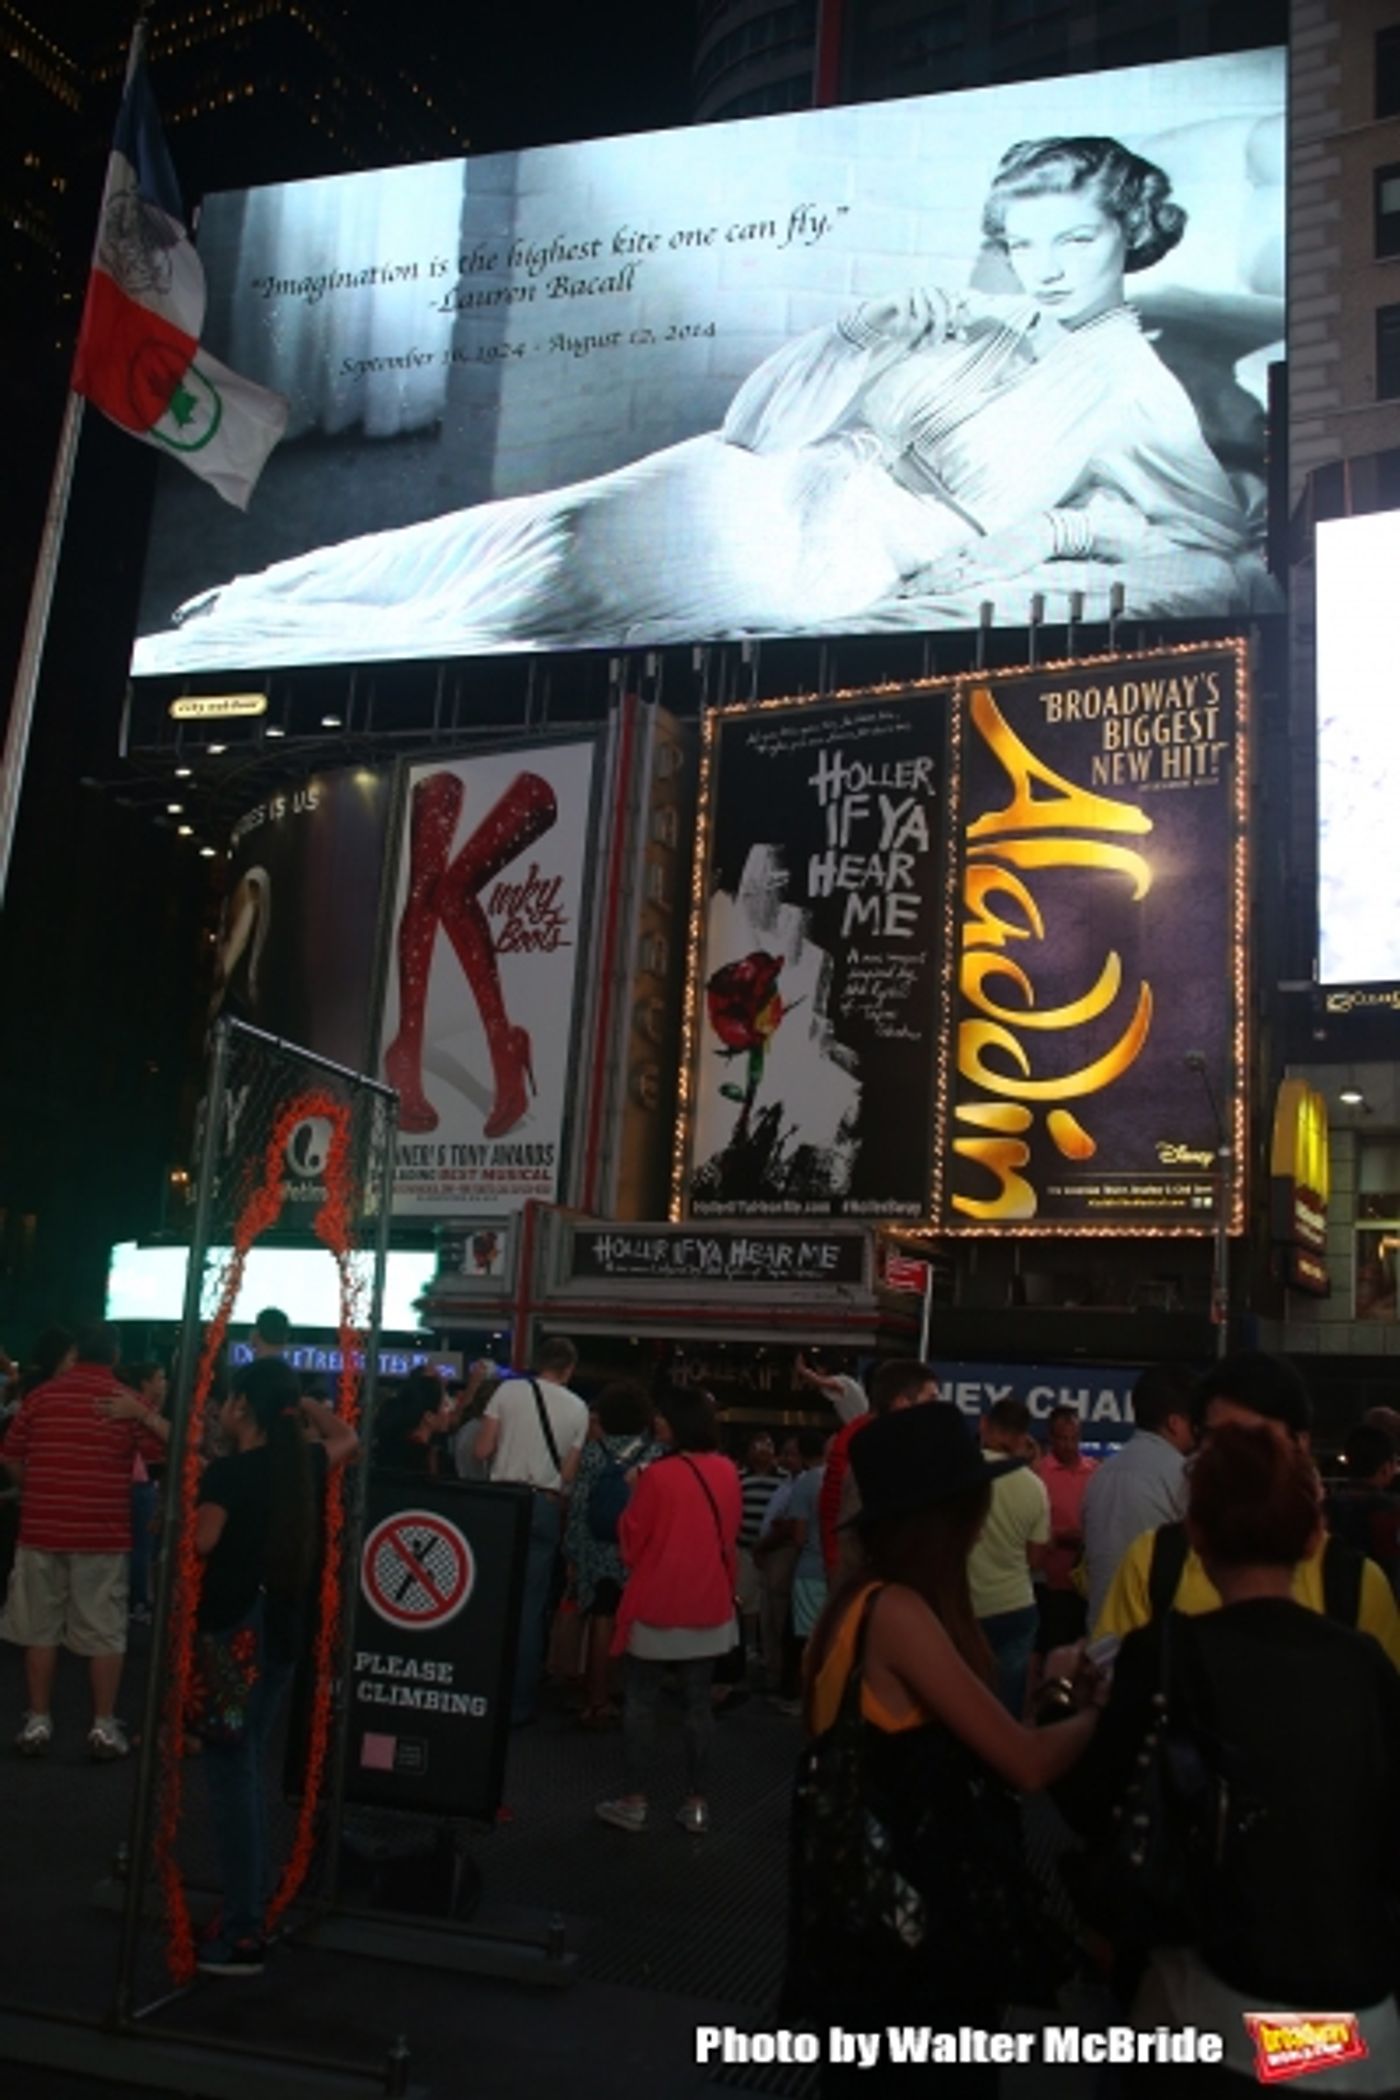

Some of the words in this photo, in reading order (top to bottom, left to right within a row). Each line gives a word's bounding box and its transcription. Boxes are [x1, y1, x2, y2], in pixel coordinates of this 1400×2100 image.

[429, 255, 449, 277] is
[459, 241, 498, 275] the
[507, 232, 602, 276] highest
[611, 224, 662, 255] kite
[668, 225, 719, 250] one
[725, 219, 776, 242] can
[546, 259, 644, 299] Bacall
[339, 347, 434, 382] September
[475, 342, 526, 365] 1924
[549, 328, 622, 358] August
[629, 327, 656, 346] 12,
[664, 321, 717, 341] 2014
[1102, 707, 1220, 751] BIGGEST
[807, 748, 936, 807] HOLLER
[1091, 749, 1153, 785] NEW
[826, 793, 870, 849] IF
[877, 793, 929, 853] YA
[807, 849, 916, 898] HEAR
[840, 891, 922, 938] ME
[953, 688, 1153, 1220] Aladdin
[439, 1168, 479, 1181] BEST
[481, 1168, 552, 1181] MUSICAL
[491, 1143, 555, 1166] AWARDS
[672, 1237, 697, 1266] IF
[697, 1238, 724, 1269] YA
[728, 1238, 794, 1267] HEAR
[797, 1240, 842, 1270] ME
[353, 1651, 454, 1685] PLEASE
[356, 1680, 488, 1717] CLIMBING
